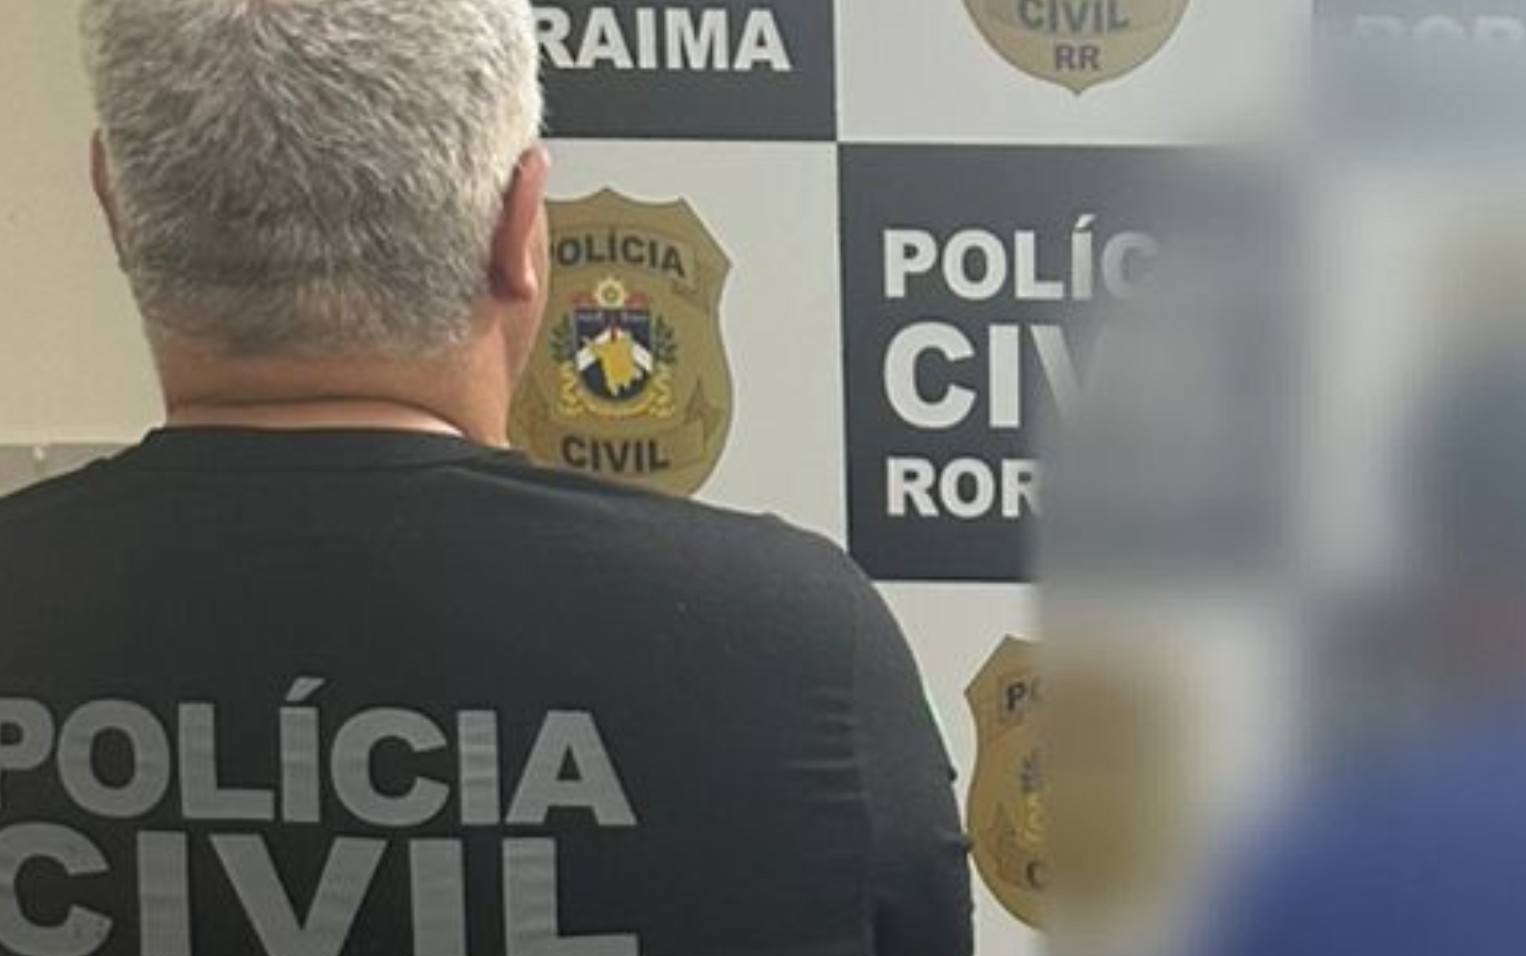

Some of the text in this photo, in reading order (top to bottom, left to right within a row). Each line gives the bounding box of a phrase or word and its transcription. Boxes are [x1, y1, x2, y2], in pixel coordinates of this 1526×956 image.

[1017, 0, 1131, 34] CIVIL
[1055, 45, 1100, 71] RR
[551, 230, 686, 278] OLÍCIA
[559, 434, 671, 473] CIVIL
[0, 677, 638, 828] POLÍCIA
